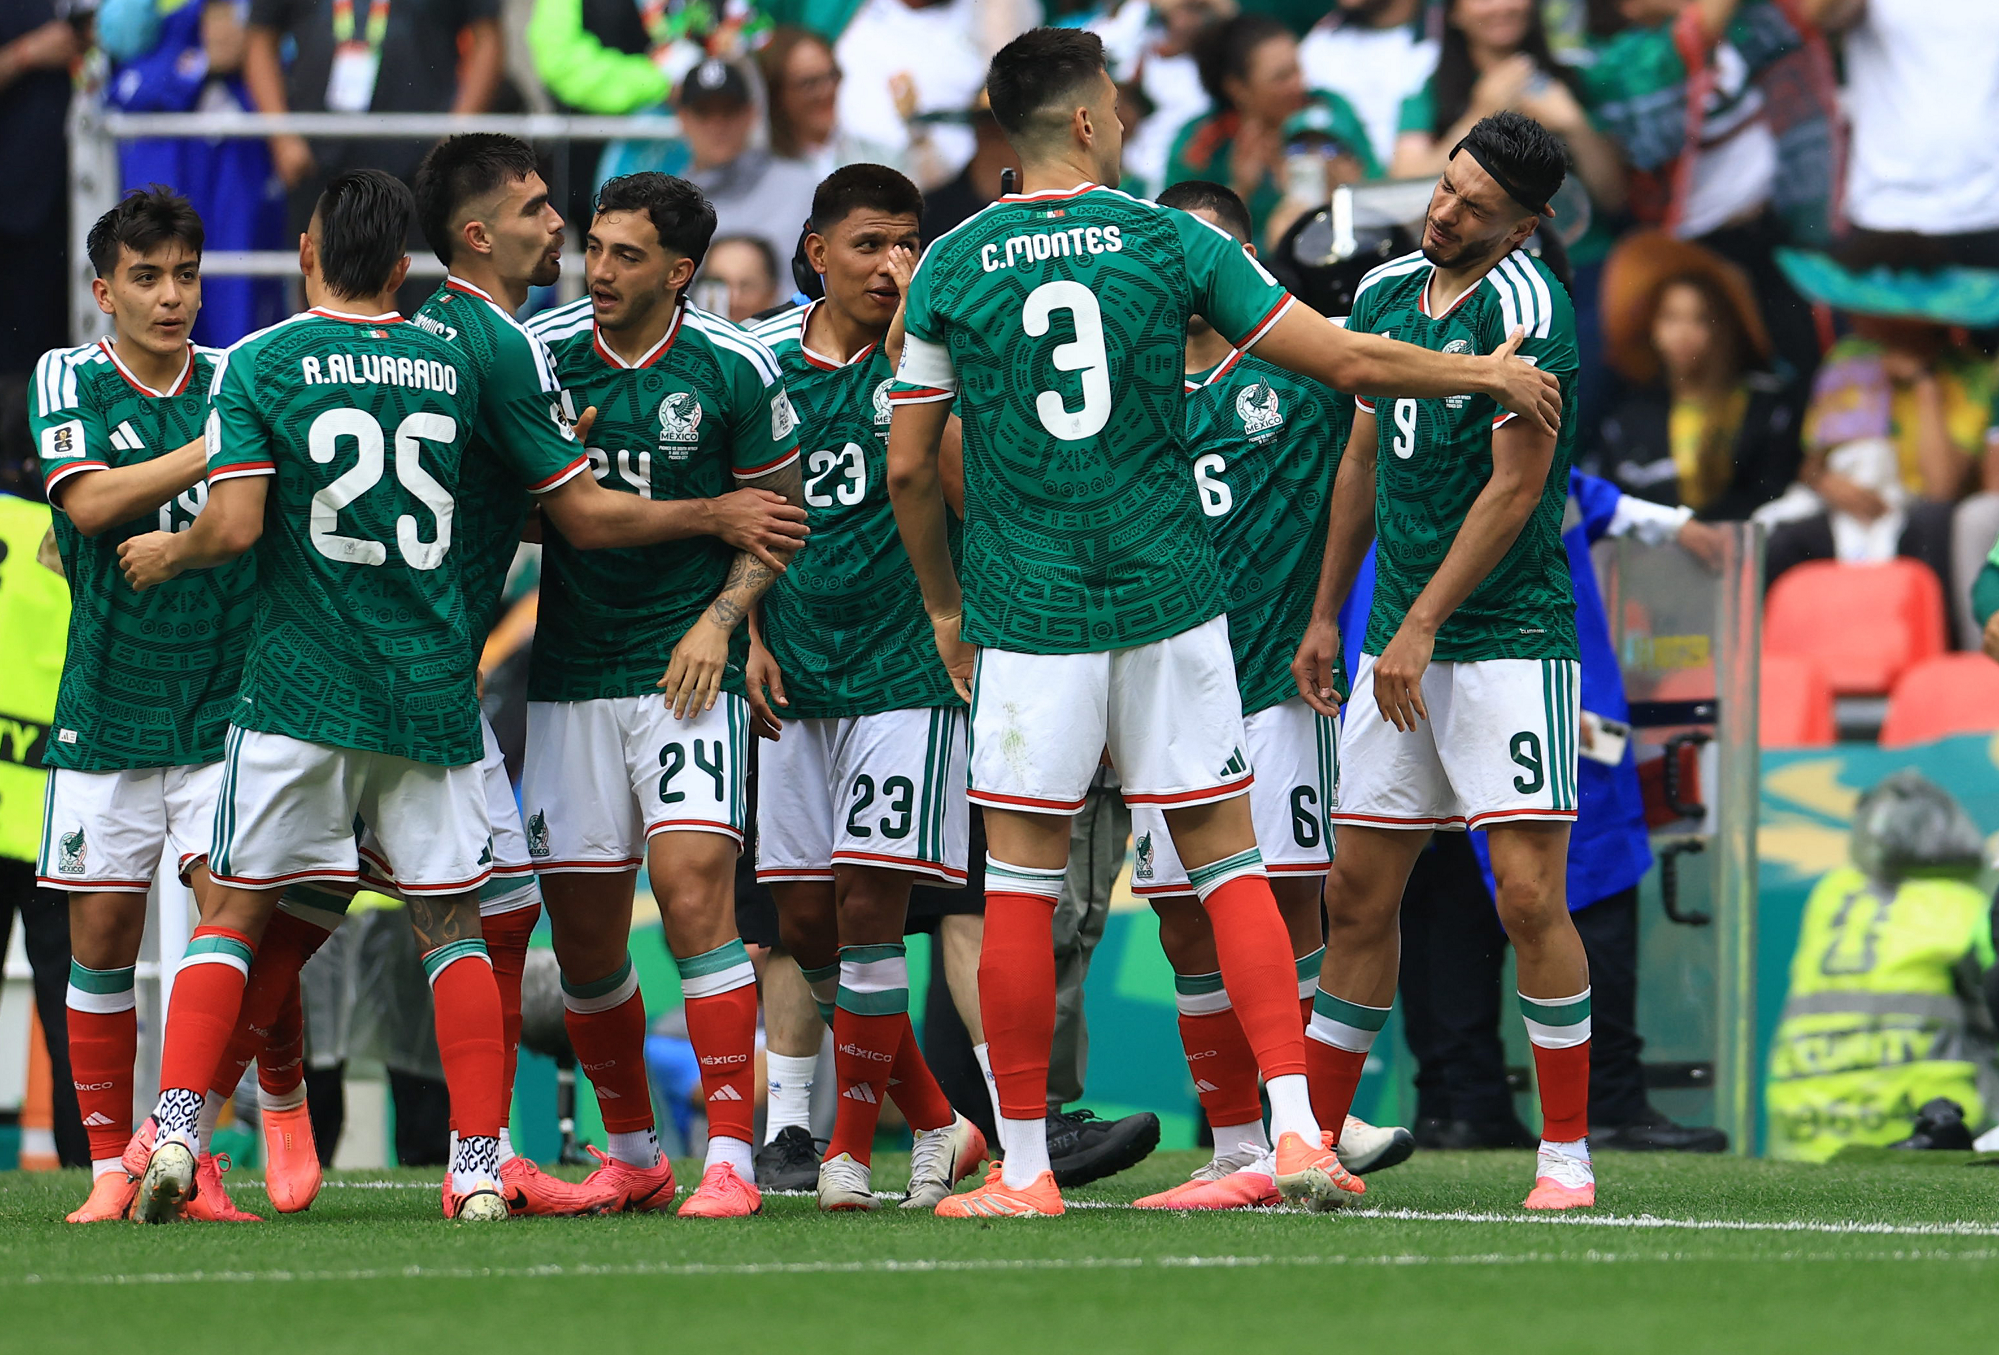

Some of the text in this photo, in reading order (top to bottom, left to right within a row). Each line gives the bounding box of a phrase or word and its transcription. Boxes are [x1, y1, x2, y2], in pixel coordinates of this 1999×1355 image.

[981, 225, 1123, 272] C.MONTES
[302, 354, 457, 395] R.ALVARADO
[1022, 280, 1112, 440] 3
[661, 431, 697, 441] MÉXICO
[1246, 416, 1281, 433] MÉXICO
[1393, 398, 1417, 459] 9
[308, 408, 457, 570] 25
[805, 442, 866, 507] 23
[1194, 453, 1233, 516] 6
[659, 738, 724, 804] 24
[1509, 731, 1545, 795] 9
[846, 773, 914, 839] 23
[1290, 785, 1320, 848] 6
[583, 1059, 617, 1071] XICO
[700, 1054, 747, 1066] MÉXICO
[839, 1043, 893, 1063] MÉXICO
[74, 1080, 113, 1091] ÉXICO
